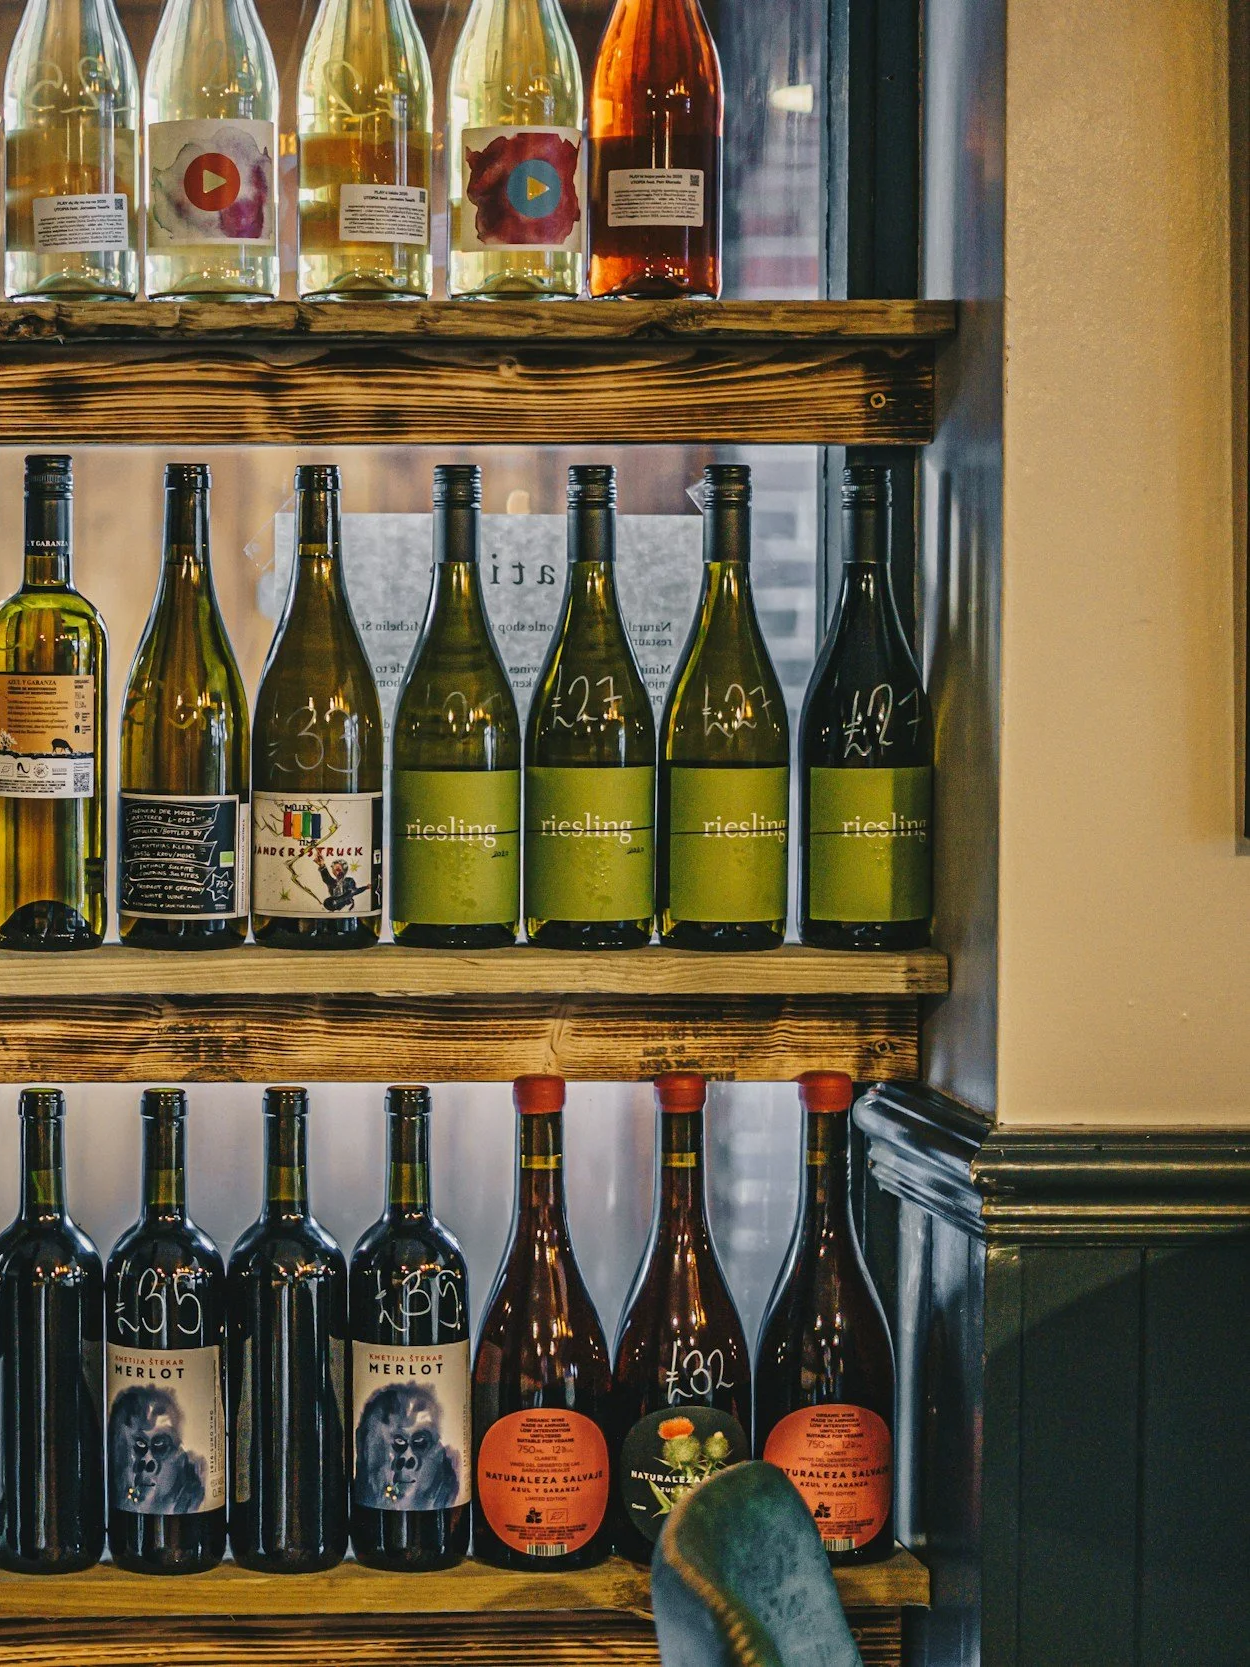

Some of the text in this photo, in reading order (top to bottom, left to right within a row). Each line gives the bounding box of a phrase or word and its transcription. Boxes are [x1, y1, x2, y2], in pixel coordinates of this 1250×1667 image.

[551, 664, 623, 729] £27
[284, 803, 313, 812] MÜLLER
[406, 816, 498, 848] riesling
[540, 812, 632, 844] riesling
[702, 812, 786, 843] riesling
[842, 812, 926, 842] riesling
[168, 864, 195, 872] SULFITE
[170, 871, 200, 880] SULFITES
[175, 885, 205, 894] GERMANY
[114, 1259, 201, 1334] £35
[115, 1355, 184, 1366] KMETIJA ŠTEKAR
[369, 1354, 444, 1362] KMETIJA ŠTEKAR
[115, 1364, 185, 1379] MERLOT
[370, 1363, 444, 1375] MERLOT
[666, 1341, 734, 1404] £32
[486, 1470, 604, 1484] NATURALEZA SALVAJE
[631, 1470, 701, 1484] NATURALEZA
[784, 1468, 846, 1479] TURALEZA
